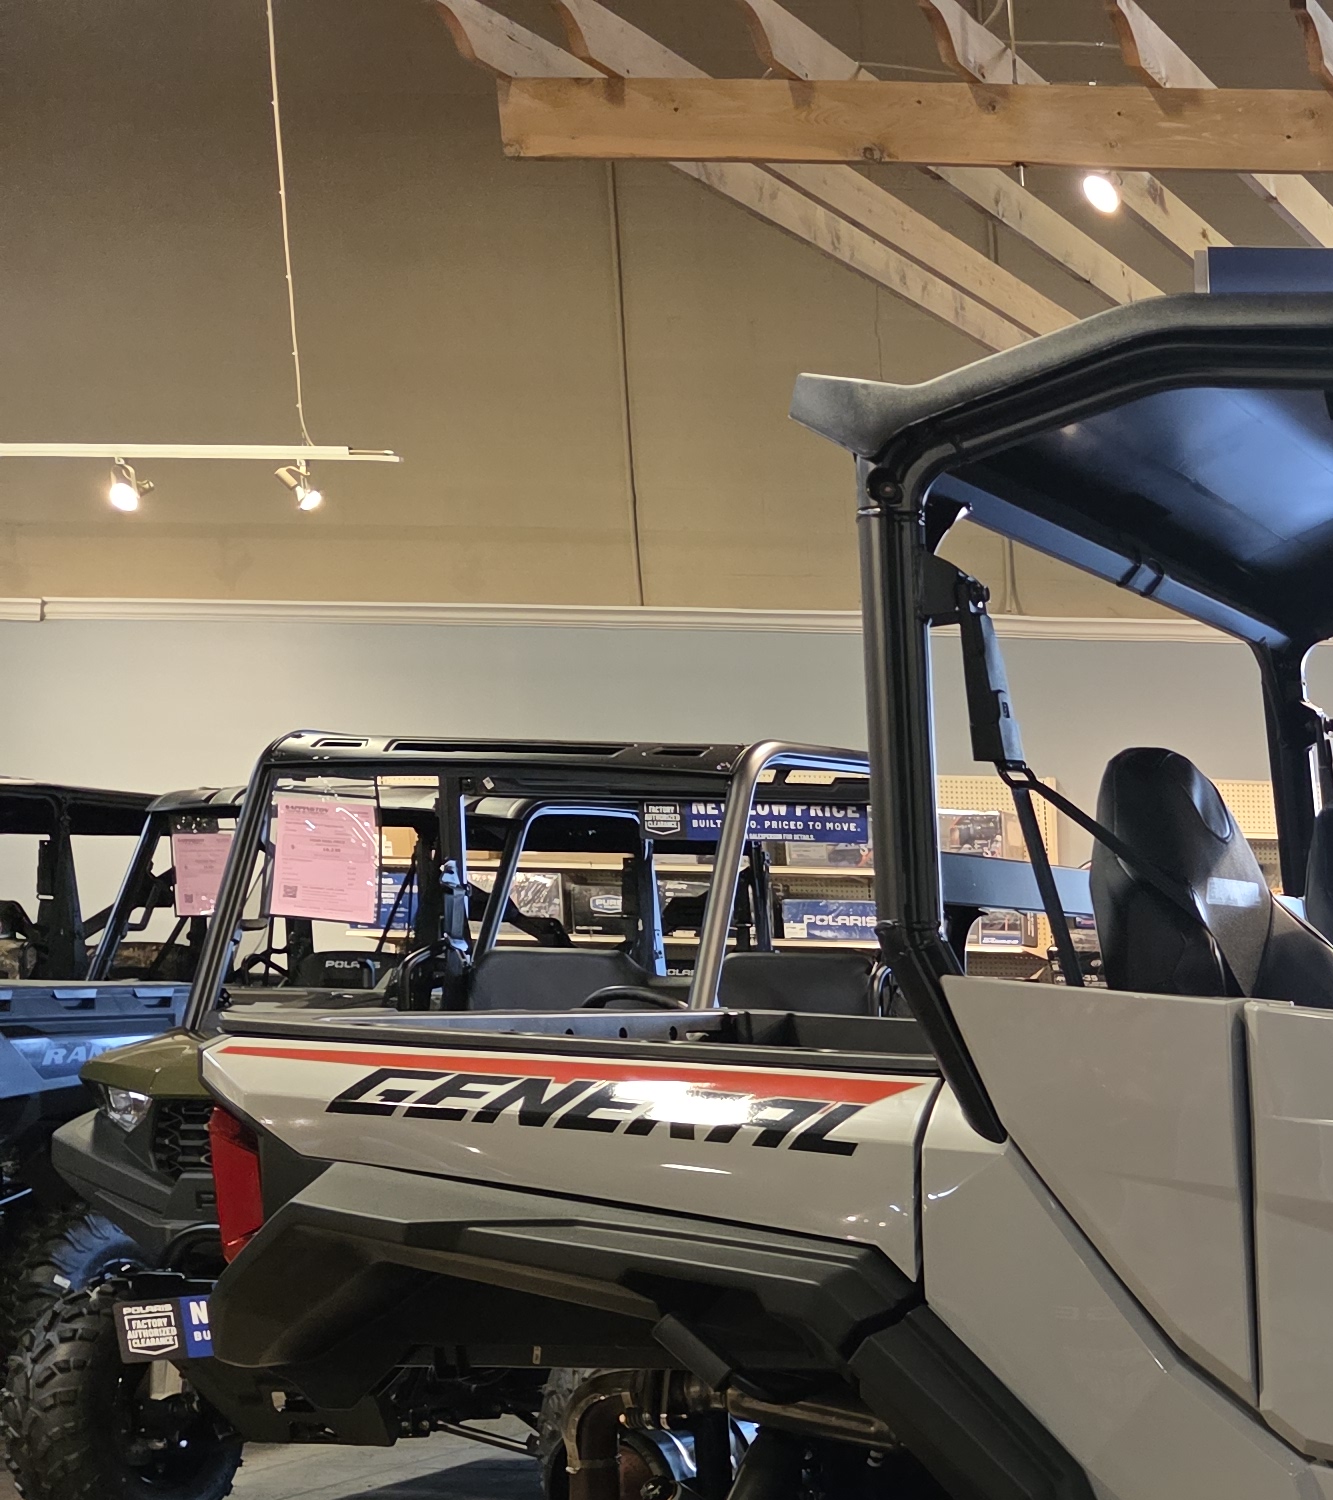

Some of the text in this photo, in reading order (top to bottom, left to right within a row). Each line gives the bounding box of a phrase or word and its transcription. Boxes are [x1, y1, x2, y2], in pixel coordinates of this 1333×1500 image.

[691, 803, 725, 815] NE
[795, 804, 860, 818] PRICE
[692, 819, 722, 828] BUILT
[764, 820, 804, 830] PRICED
[808, 821, 821, 830] TO
[825, 822, 861, 832] MOVE.
[803, 914, 878, 927] POLARIS
[325, 960, 380, 969] POLAS
[42, 1045, 110, 1066] RAN
[123, 1304, 173, 1315] POLARIS
[131, 1318, 168, 1329] FACTORY
[127, 1327, 177, 1340] AUTHORIZED
[132, 1336, 174, 1348] CLEARANCE
